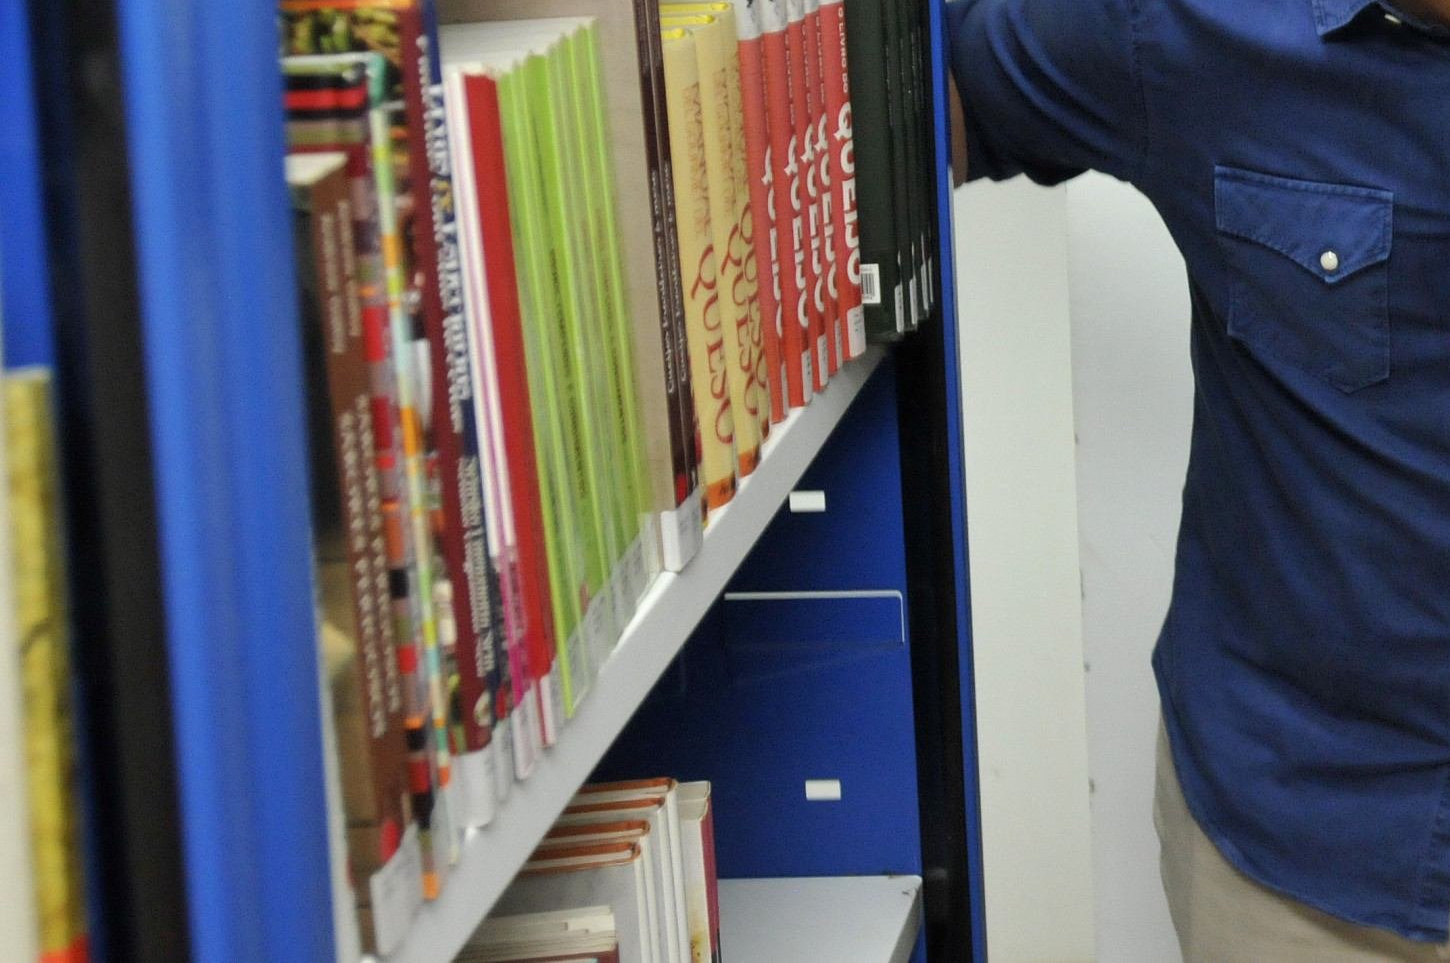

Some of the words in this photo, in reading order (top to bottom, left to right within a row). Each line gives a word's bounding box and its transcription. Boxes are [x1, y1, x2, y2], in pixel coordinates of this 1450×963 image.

[838, 22, 847, 69] LIVRO
[842, 72, 849, 94] DO
[833, 102, 861, 286] QUEIJO
